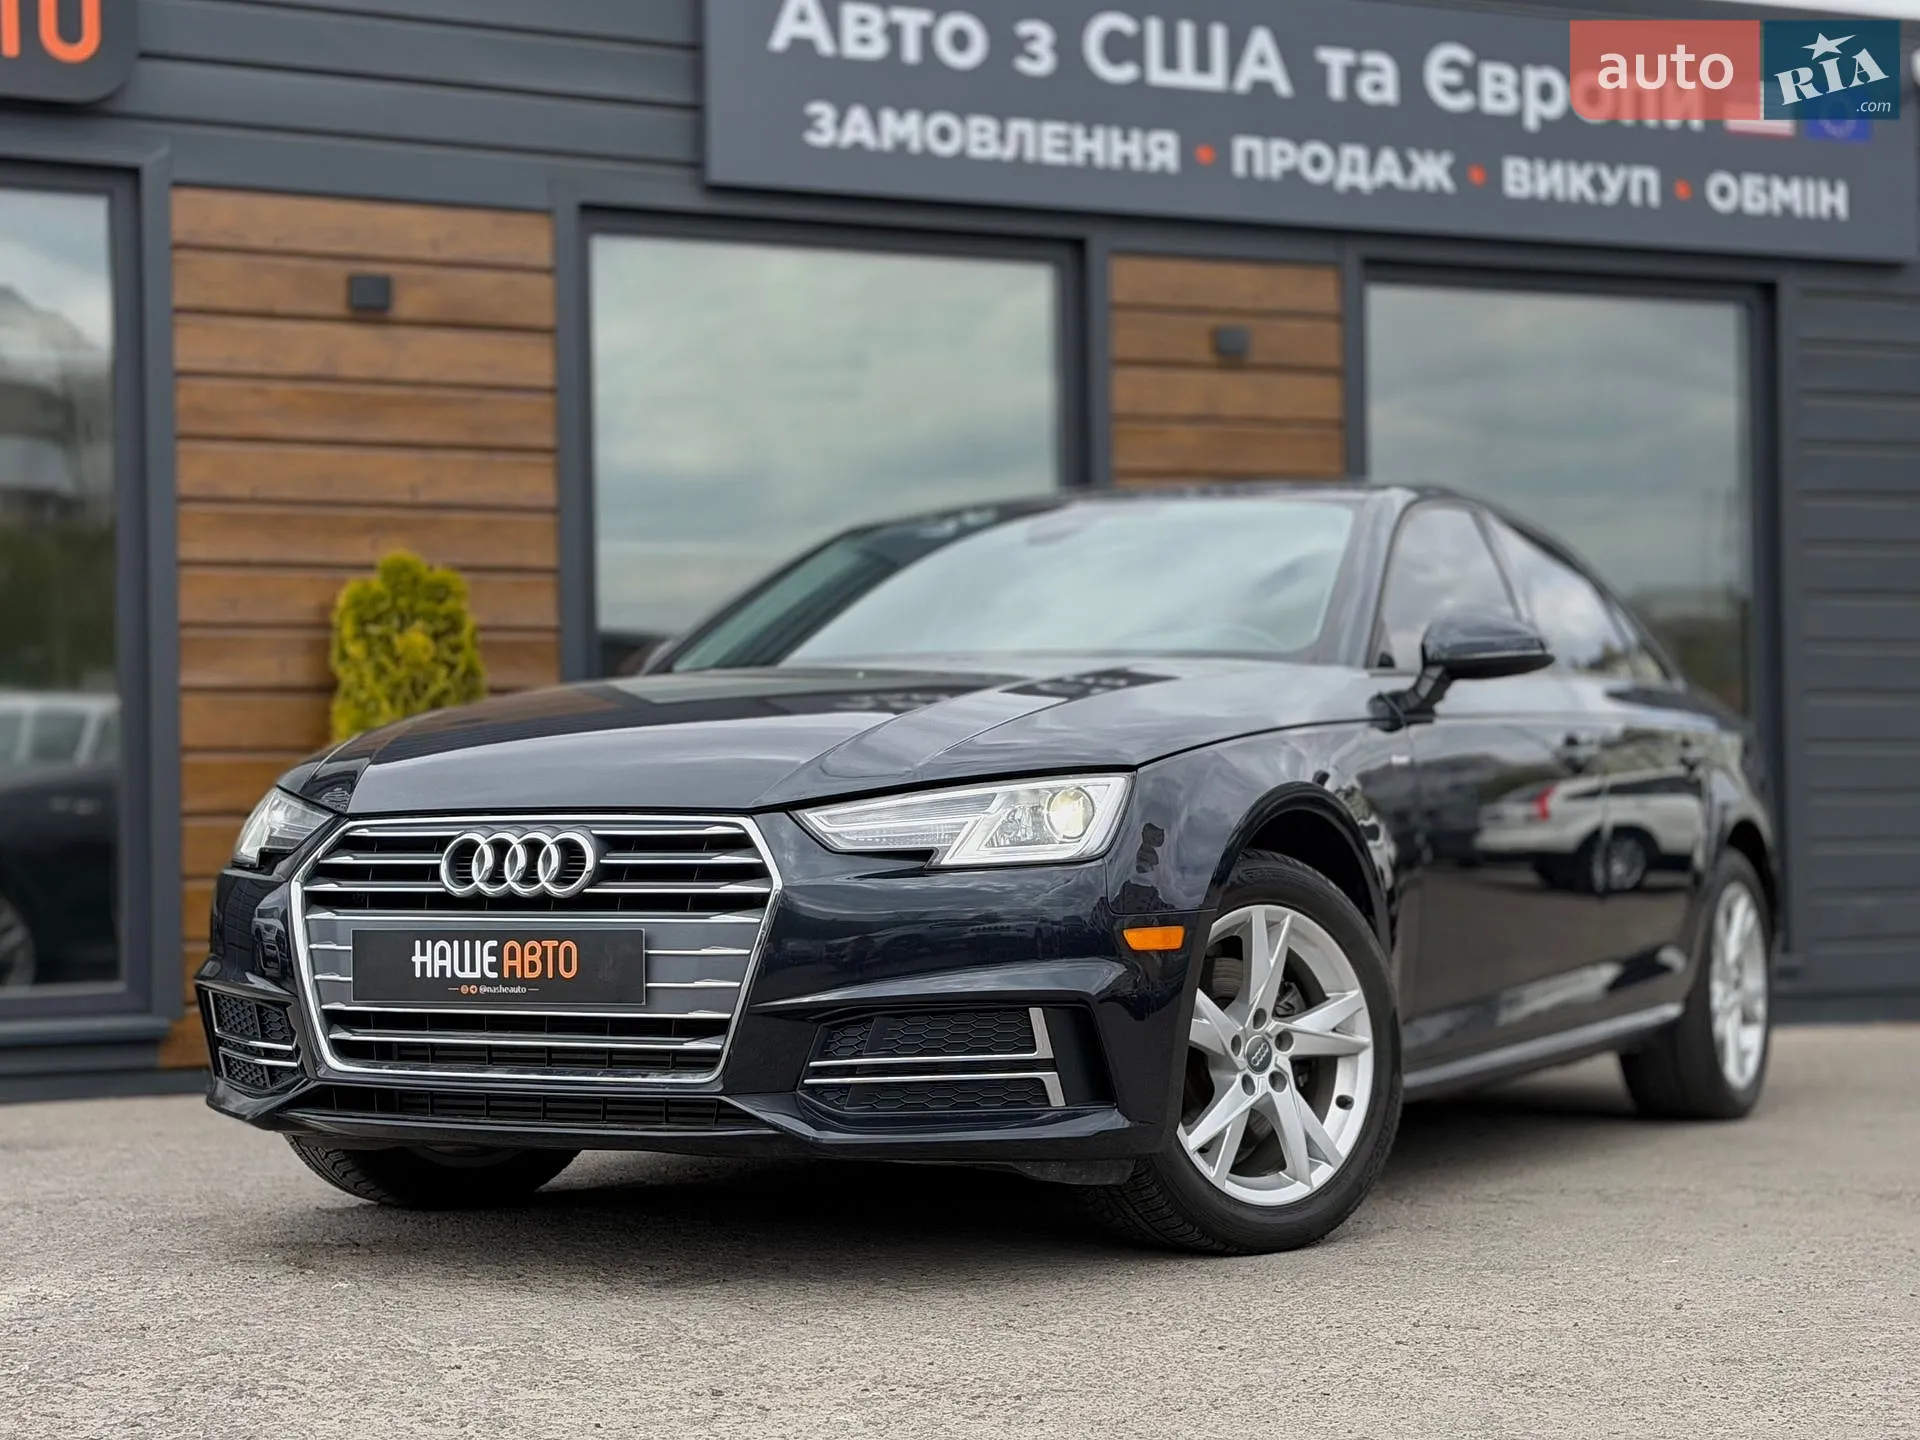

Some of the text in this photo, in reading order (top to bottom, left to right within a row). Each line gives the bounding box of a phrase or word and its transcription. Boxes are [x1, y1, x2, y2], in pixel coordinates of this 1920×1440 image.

[768, 0, 990, 71] Авто
[1012, 18, 1059, 78] з
[1081, 9, 1295, 98] США
[1314, 45, 1401, 107] та
[802, 99, 1850, 221] ЗАМОВЛЕННЯ ПРОДАЖ ВИКУП ОБМІН
[411, 939, 579, 980] НАШЕ АВТО
[479, 984, 527, 995] @nasheauto
